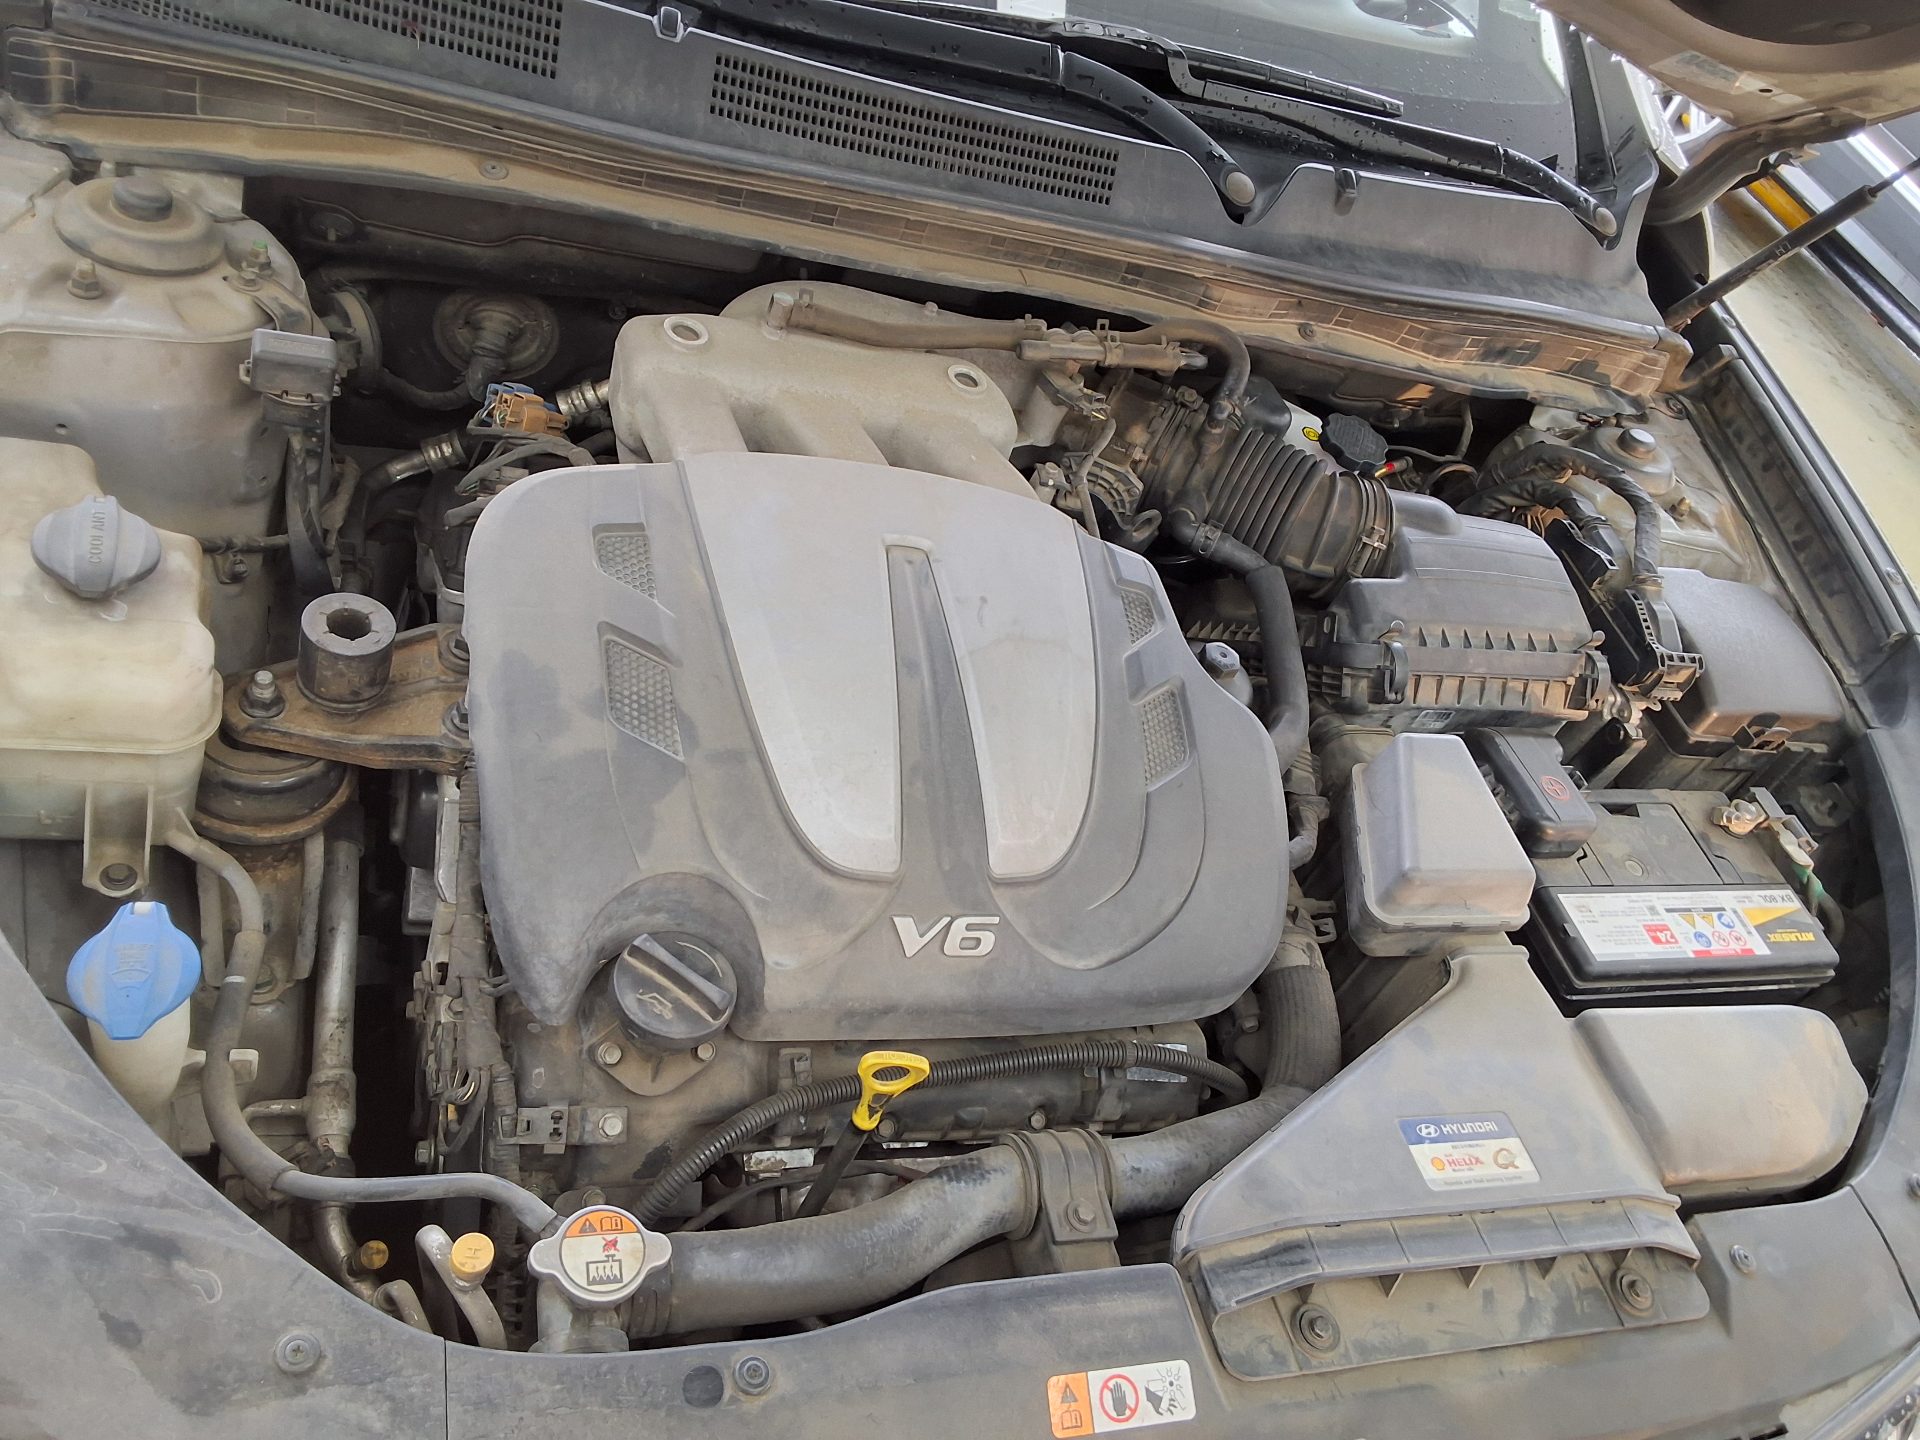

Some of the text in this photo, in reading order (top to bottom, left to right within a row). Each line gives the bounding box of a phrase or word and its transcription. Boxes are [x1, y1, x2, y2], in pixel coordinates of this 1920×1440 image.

[88, 511, 106, 564] COOLANT
[1779, 894, 1795, 903] BX
[892, 915, 1001, 958] V6
[1655, 930, 1676, 943] 24
[1440, 1120, 1499, 1135] HYUNDAI
[1446, 1156, 1485, 1168] HELIX
